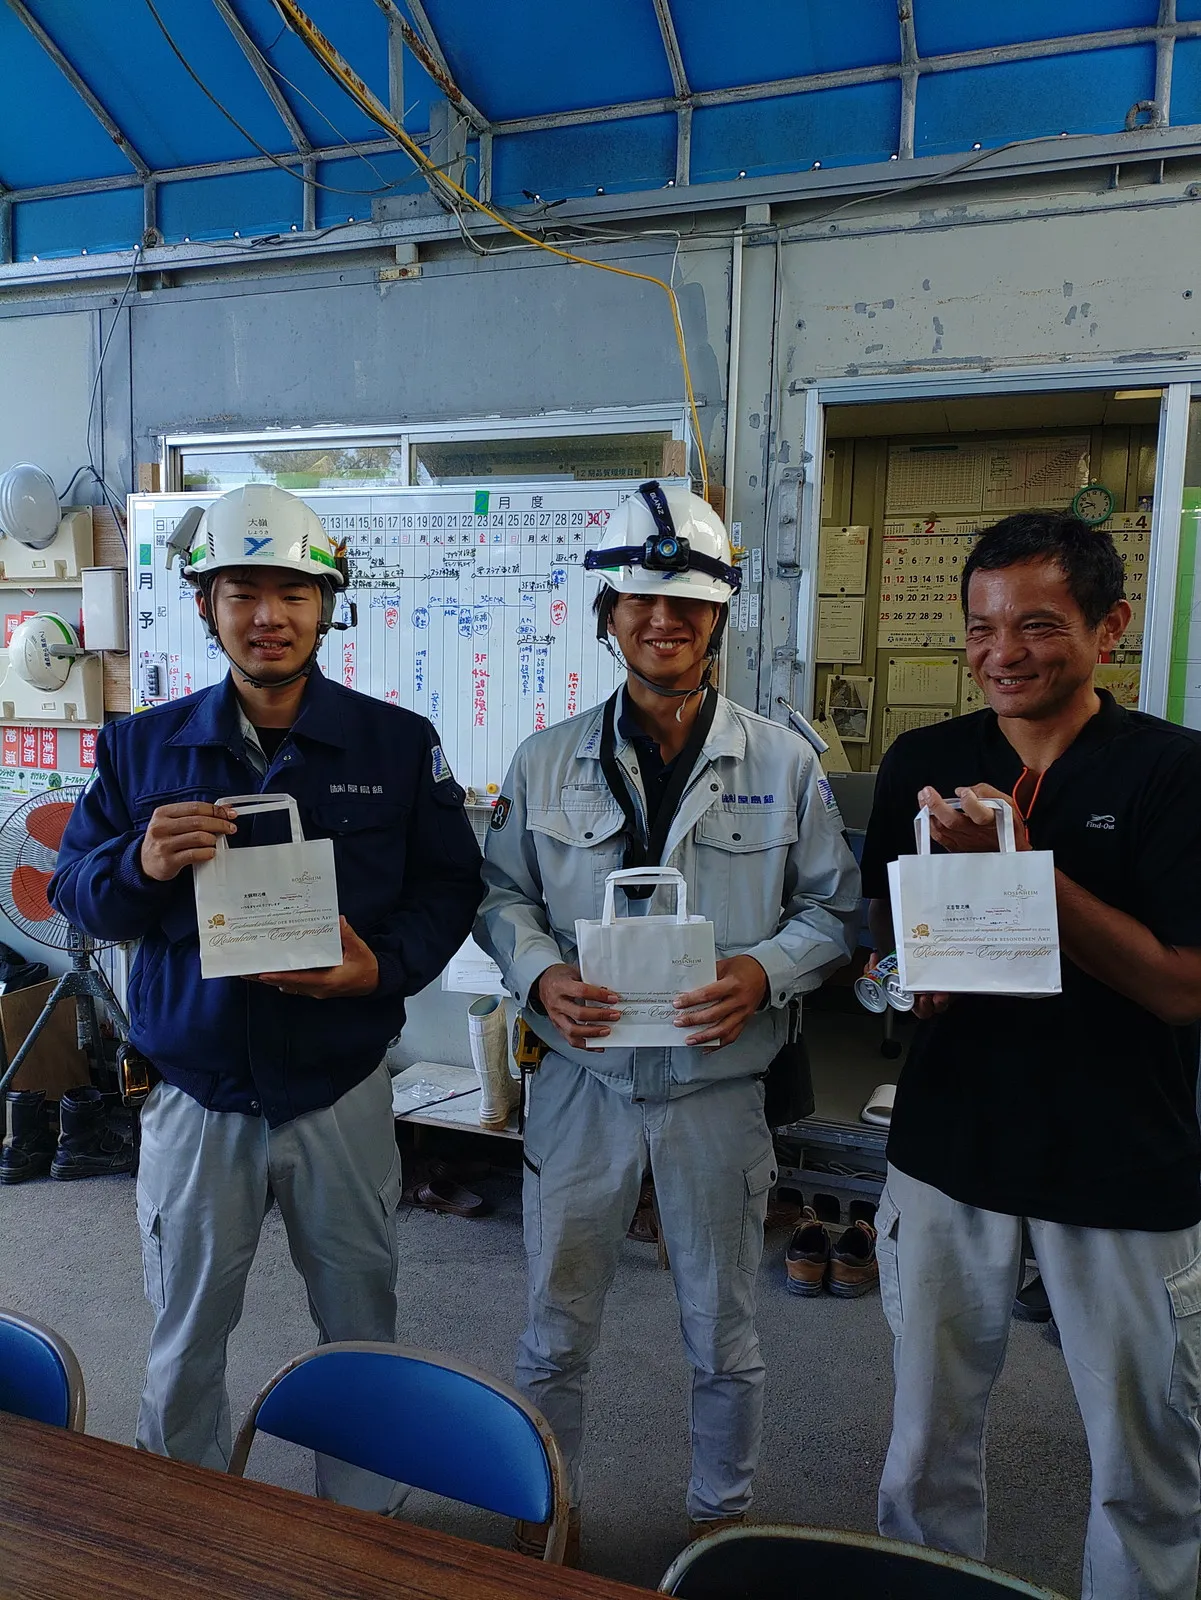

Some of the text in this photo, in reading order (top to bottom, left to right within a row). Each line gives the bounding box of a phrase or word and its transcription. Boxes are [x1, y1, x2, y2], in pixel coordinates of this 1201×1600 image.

[156, 519, 165, 531] 日
[330, 517, 341, 528] 13
[344, 517, 354, 528] 14
[359, 516, 369, 528] 15
[373, 516, 383, 528] 16
[388, 516, 398, 528] 17
[402, 516, 412, 527] 18
[417, 515, 428, 527] 19
[432, 515, 443, 527] 20
[447, 515, 457, 527] 21
[462, 515, 472, 527] 22
[477, 515, 488, 526] 23
[492, 514, 503, 526] 24
[508, 514, 519, 526] 25
[523, 513, 535, 525] 26
[539, 514, 551, 525] 27
[555, 513, 567, 525] 28
[571, 513, 583, 525] 29
[1135, 515, 1147, 529] 4
[924, 522, 935, 534] 2
[374, 536, 381, 544] 金
[419, 534, 426, 542] 月
[433, 535, 440, 543] 火
[447, 534, 455, 542] 水
[461, 534, 468, 542] 木
[493, 534, 500, 542] 土
[528, 534, 535, 542] 月
[540, 534, 548, 542] 火
[556, 535, 564, 543] 水
[573, 532, 581, 540] 木
[953, 537, 959, 545] 2
[1122, 533, 1144, 542] 2 3
[925, 556, 930, 564] 7
[1121, 553, 1145, 562] 9 10
[909, 575, 918, 583] 13
[922, 575, 931, 583] 14
[1123, 573, 1143, 581] 6 17
[933, 593, 944, 601] 22
[947, 593, 957, 601] 23
[880, 612, 890, 620] 25
[893, 612, 903, 620] 26
[906, 612, 916, 620] 27
[42, 727, 55, 765] 全実施
[209, 932, 258, 947] Rosenheim
[912, 944, 964, 959] Rosenheim
[975, 944, 1012, 960] Europa
